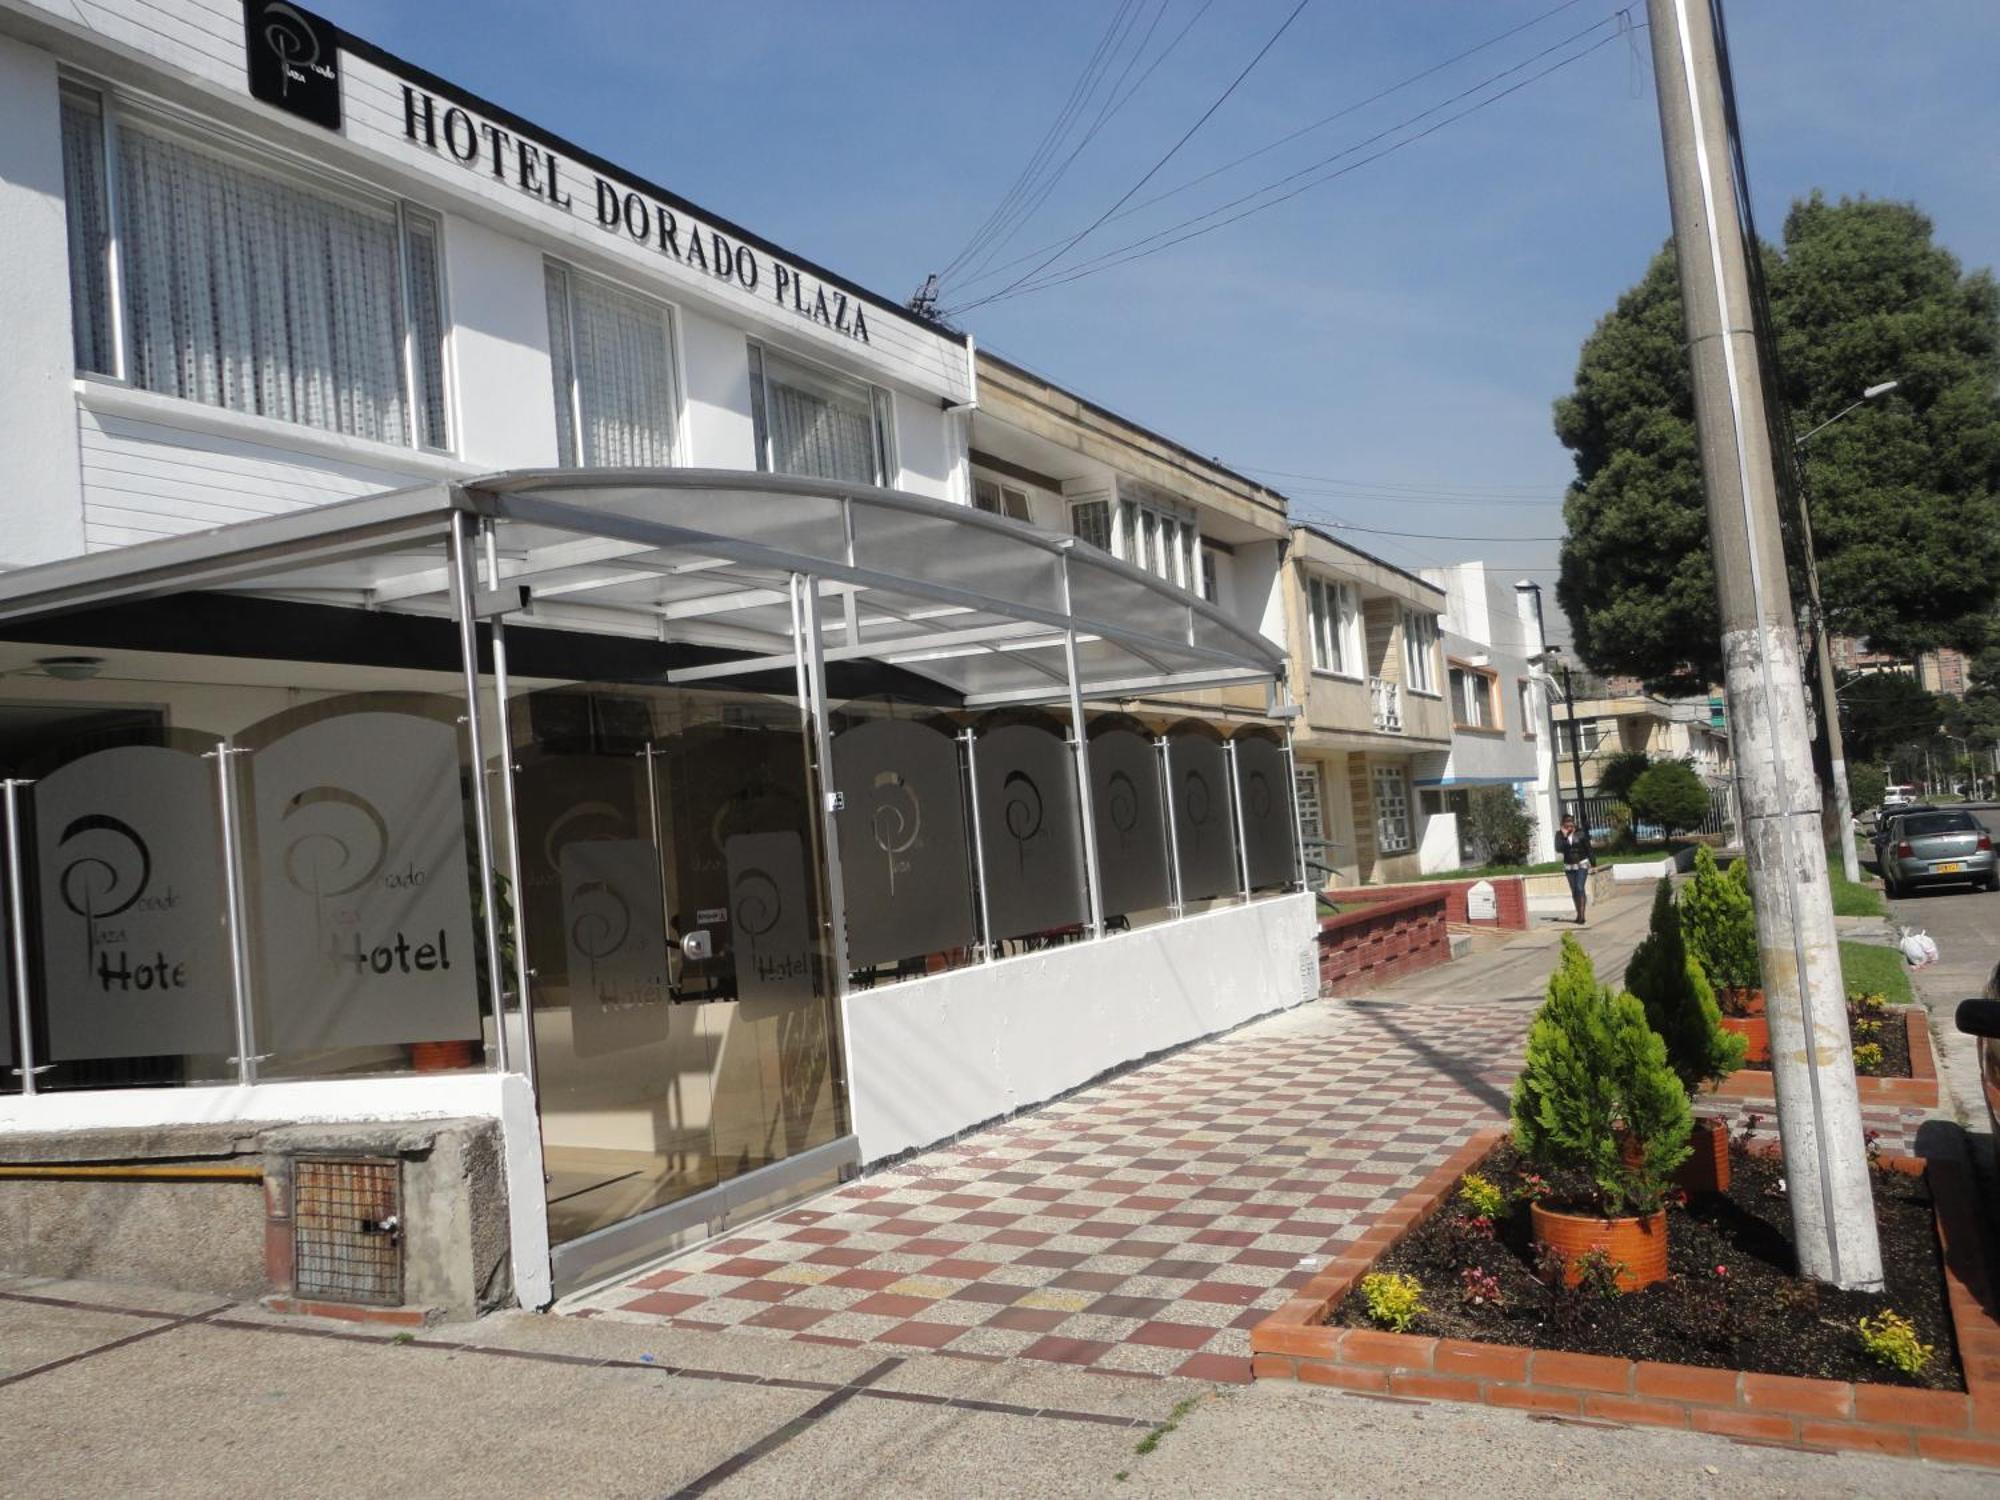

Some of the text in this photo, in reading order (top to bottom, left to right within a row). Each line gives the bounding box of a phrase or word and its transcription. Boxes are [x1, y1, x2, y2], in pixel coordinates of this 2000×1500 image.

[399, 83, 871, 343] HOTEL DORADO PLAZA
[98, 950, 187, 992] Hote
[328, 928, 452, 976] Hotel
